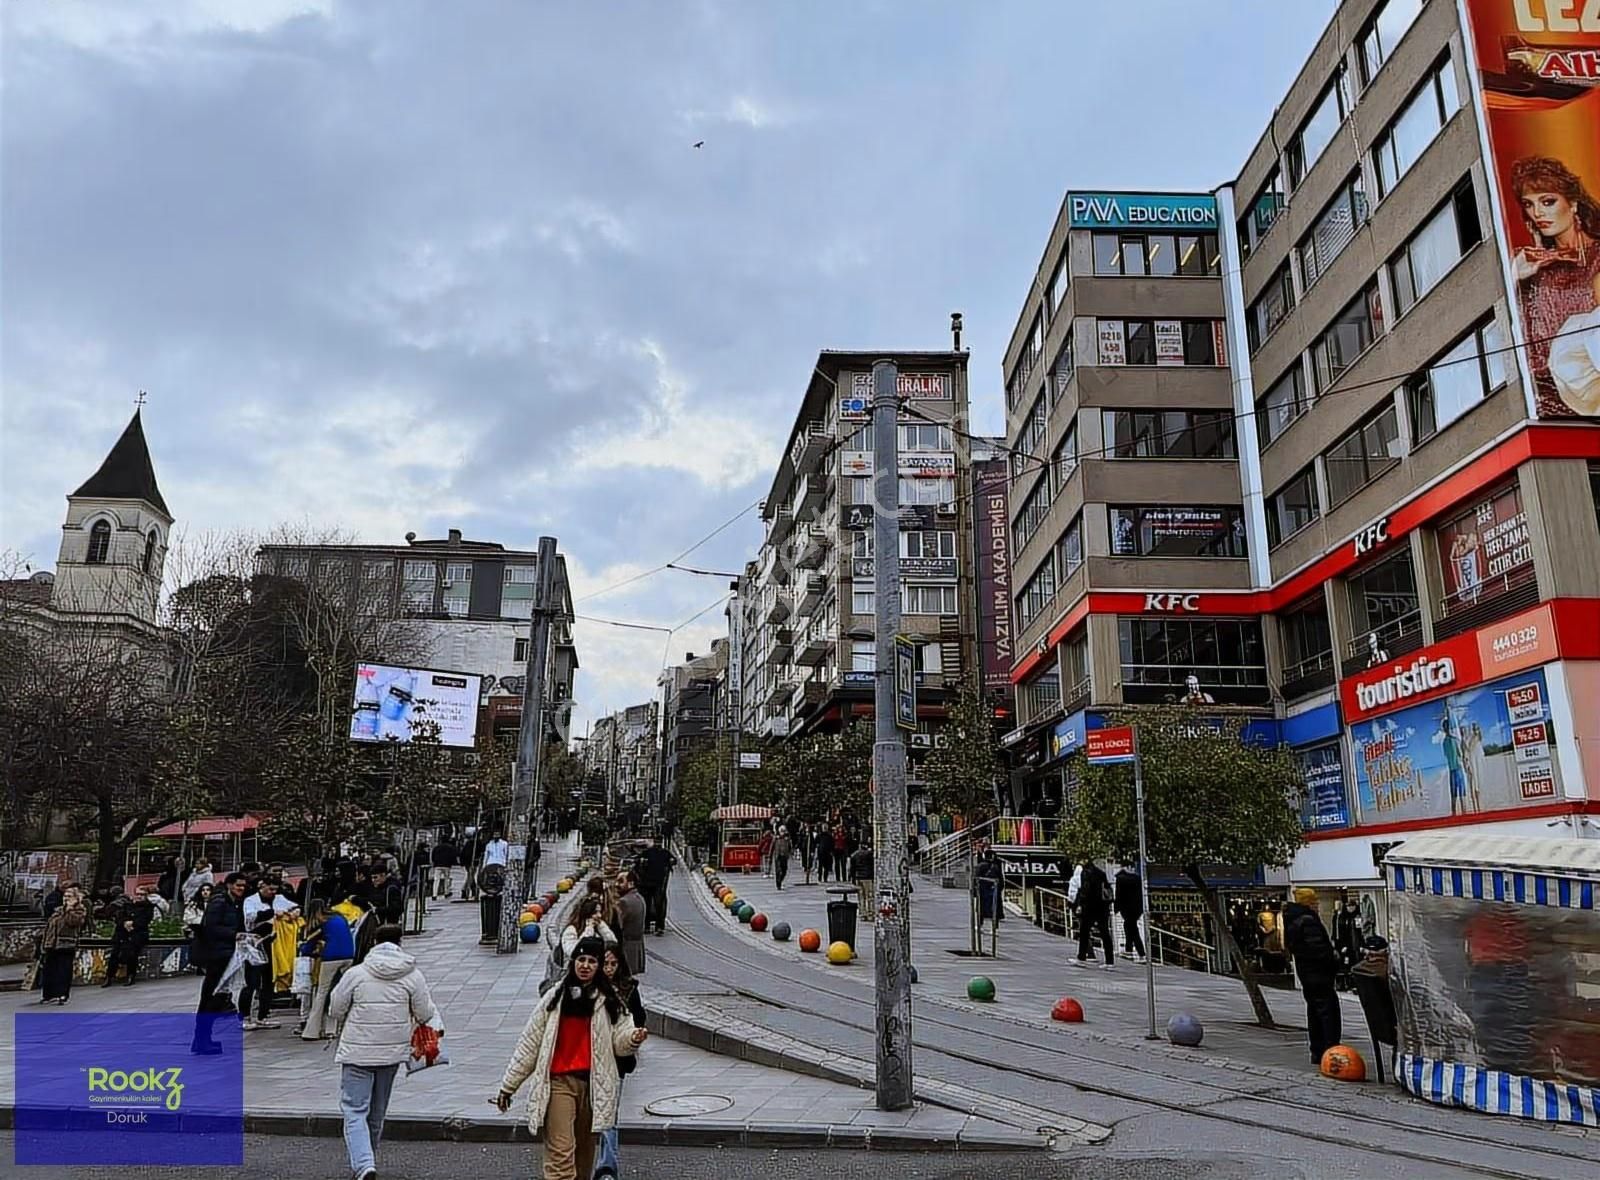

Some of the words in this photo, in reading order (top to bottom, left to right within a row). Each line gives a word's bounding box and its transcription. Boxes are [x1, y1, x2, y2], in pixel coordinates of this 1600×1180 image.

[1073, 198, 1124, 221] PAVA
[1128, 207, 1216, 222] EDUCATION
[988, 493, 1008, 586] AKADEMİSİ
[1354, 518, 1388, 557] KFC
[1486, 537, 1504, 558] HER
[1504, 524, 1530, 549] ZAMA
[1513, 543, 1532, 565] ÇITI
[1144, 594, 1200, 611] KFC
[993, 591, 1011, 660] YAZILIM
[1356, 655, 1456, 711] touristica
